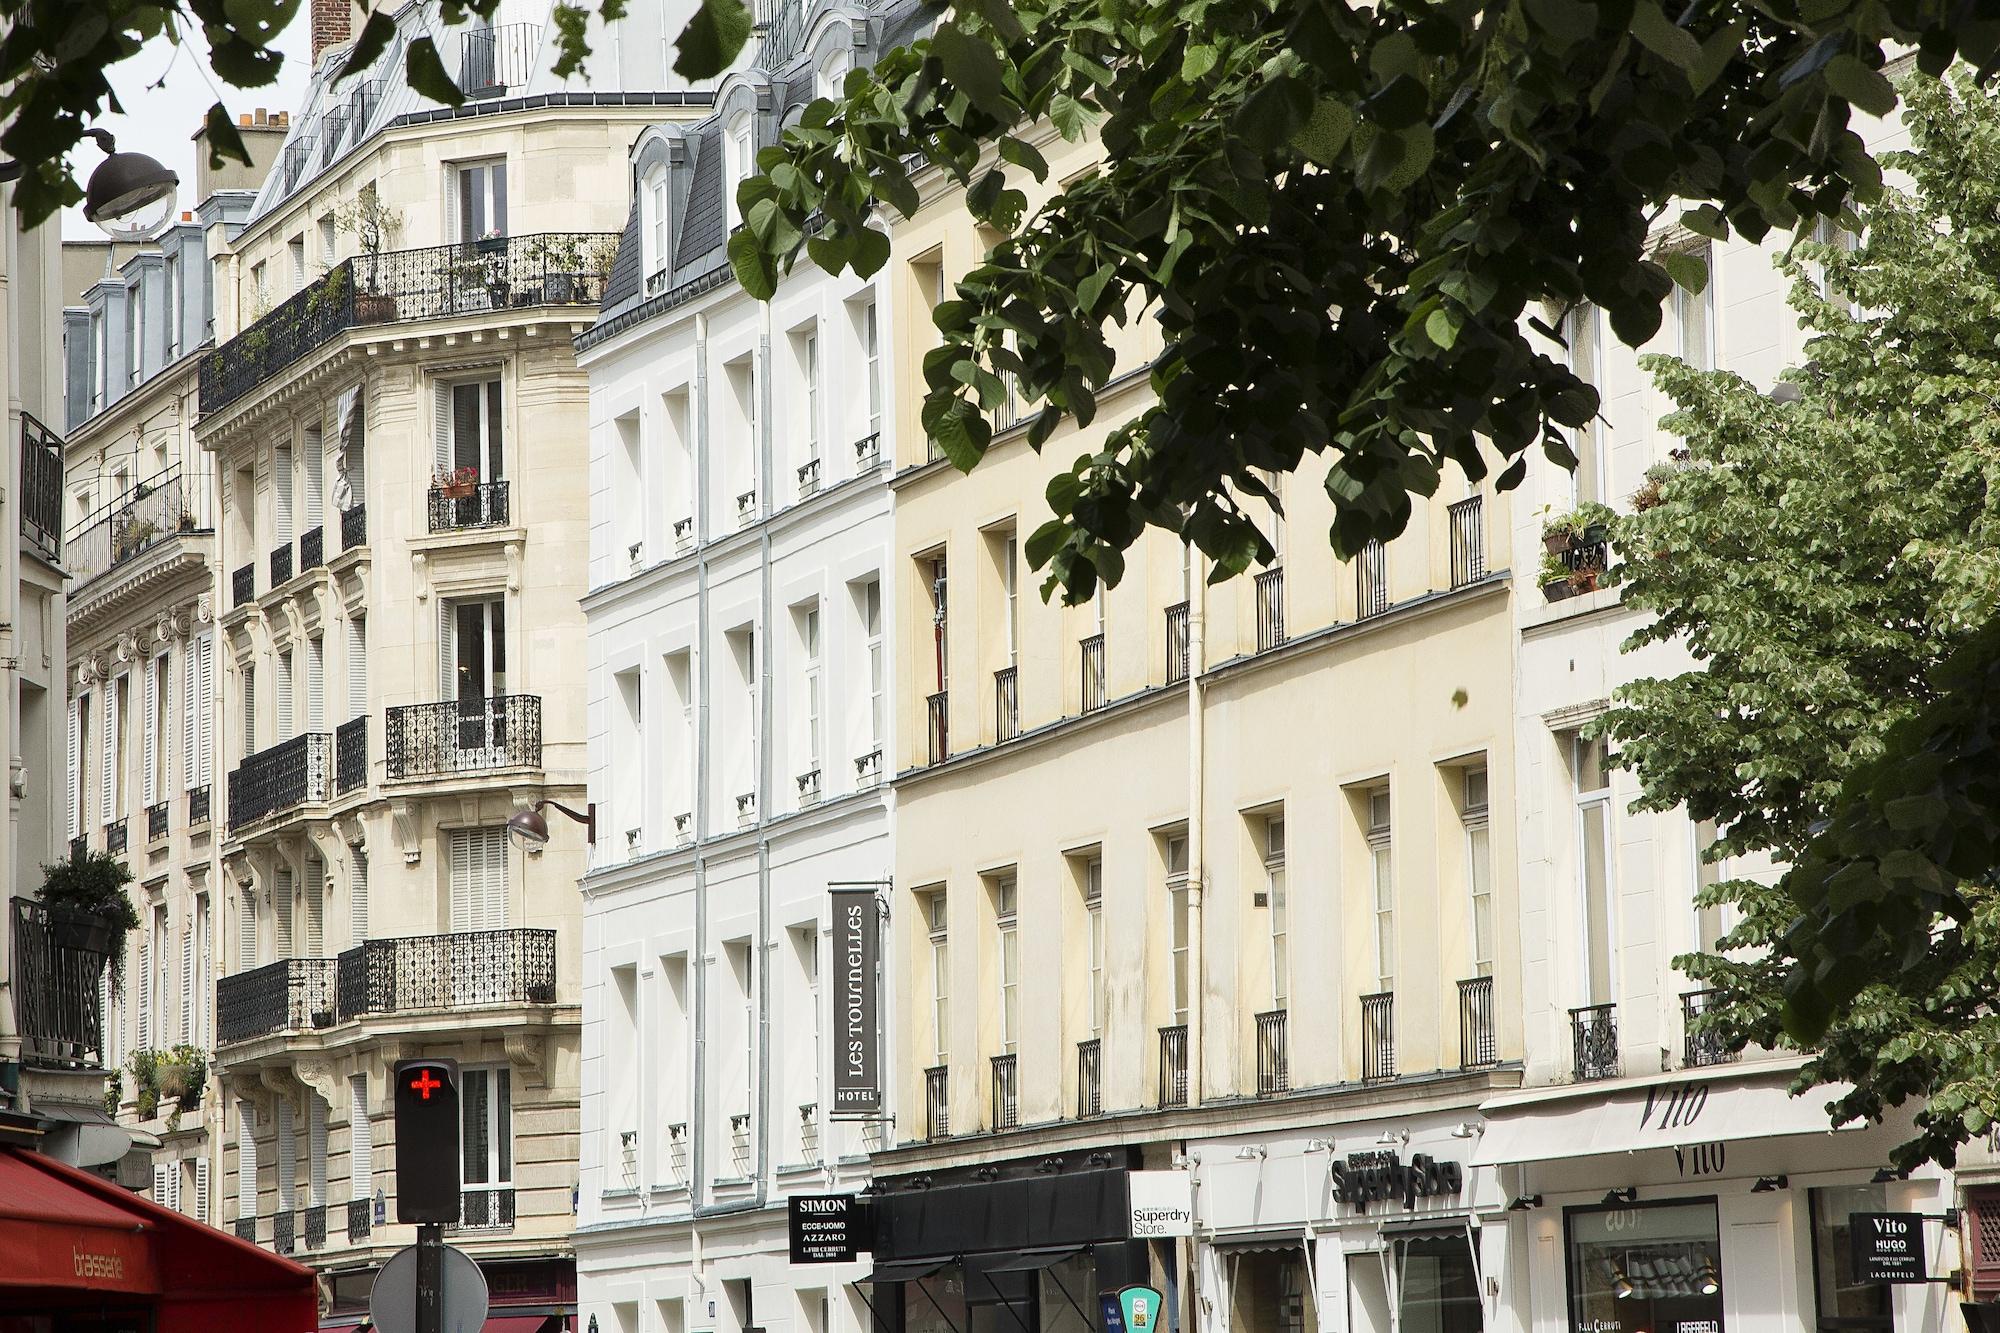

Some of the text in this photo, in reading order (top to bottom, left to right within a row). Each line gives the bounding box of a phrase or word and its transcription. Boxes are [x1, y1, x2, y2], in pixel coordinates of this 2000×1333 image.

[838, 1091, 874, 1101] HOTEL
[1639, 1080, 1709, 1132] Vito
[800, 1200, 846, 1212] SIMON
[1134, 1208, 1190, 1224] Superdry
[802, 1222, 845, 1230] ECCE-UOMO
[1134, 1222, 1167, 1235] Store.
[1873, 1218, 1907, 1233] Vito
[803, 1233, 845, 1241] AZZARO
[1876, 1240, 1906, 1249] HUGO
[73, 1244, 123, 1280] brasserie
[1134, 1313, 1145, 1322] 96
[1593, 1318, 1621, 1333] CERRUTI
